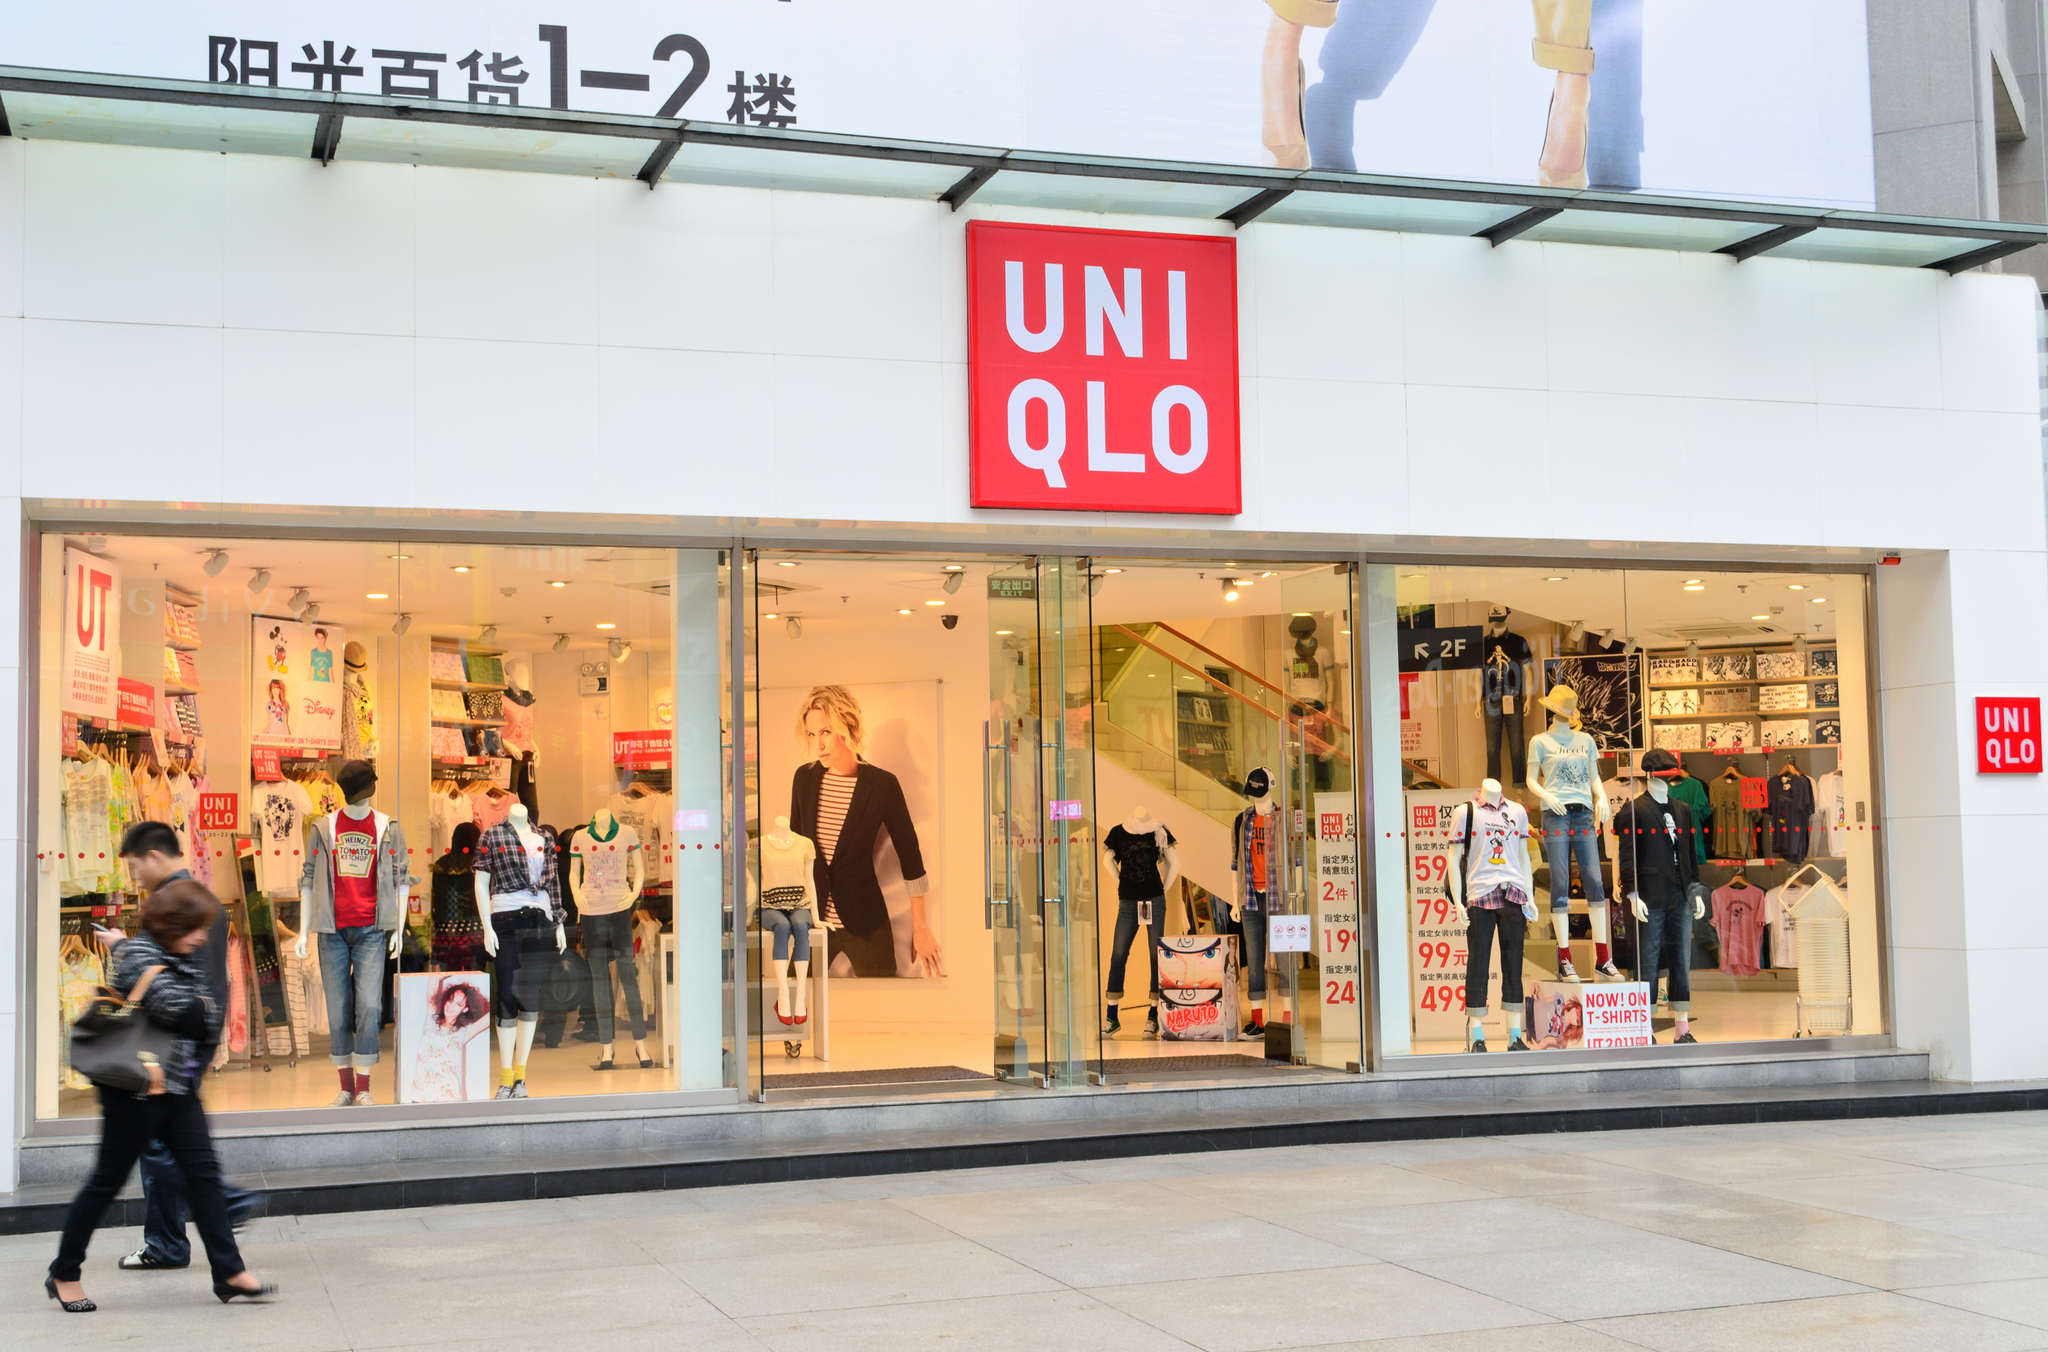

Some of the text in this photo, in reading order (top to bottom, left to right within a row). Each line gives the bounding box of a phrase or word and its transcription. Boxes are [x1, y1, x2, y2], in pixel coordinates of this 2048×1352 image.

[1005, 260, 1188, 361] UNI
[1007, 378, 1209, 488] QLO
[991, 580, 1032, 590] 安全出口
[77, 564, 112, 652] UT
[1440, 638, 1467, 658] 2F
[303, 697, 336, 721] Disney
[1984, 707, 2030, 733] UNI
[615, 741, 629, 754] UT
[1985, 738, 2036, 768] QLO
[1744, 782, 1763, 792] UNI
[203, 797, 231, 810] UNI
[203, 812, 234, 827] QLO
[1416, 808, 1432, 816] UNI
[1323, 816, 1339, 824] UNI
[1416, 817, 1434, 826] QLO
[1323, 825, 1341, 834] QLO
[344, 837, 366, 845] HEINZ
[1586, 992, 1647, 1008] NOW! ON
[1166, 1003, 1219, 1030] NARUTO
[1586, 1009, 1648, 1025] T-SHIRTS
